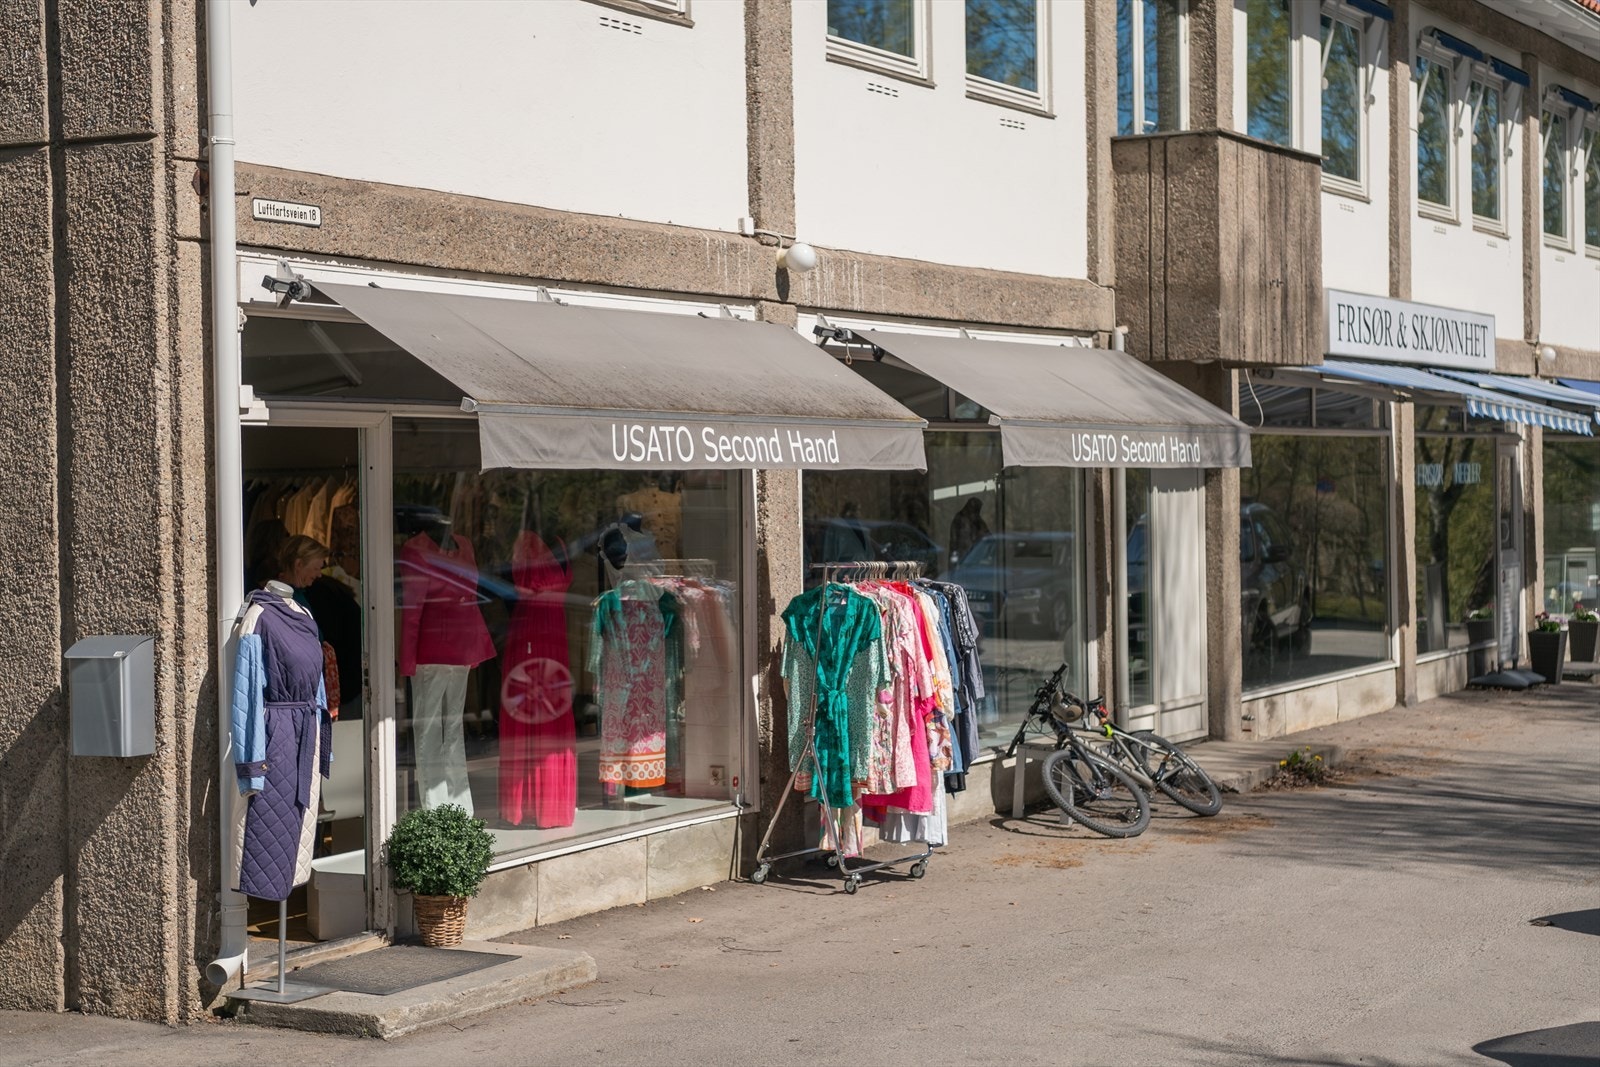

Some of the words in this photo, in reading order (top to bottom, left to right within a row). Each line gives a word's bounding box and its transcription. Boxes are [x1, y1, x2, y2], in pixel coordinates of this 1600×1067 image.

[257, 202, 308, 220] Luftfartsveien
[309, 209, 317, 221] 18
[1337, 303, 1393, 347] FRISØR
[1397, 312, 1407, 349] &
[1412, 313, 1488, 358] SKJØNNHET
[611, 423, 695, 462] USATO
[701, 426, 783, 463] Second
[787, 428, 840, 463] Hand
[1071, 433, 1117, 462] USATO
[1121, 435, 1167, 463] Second
[1170, 436, 1201, 463] Hand
